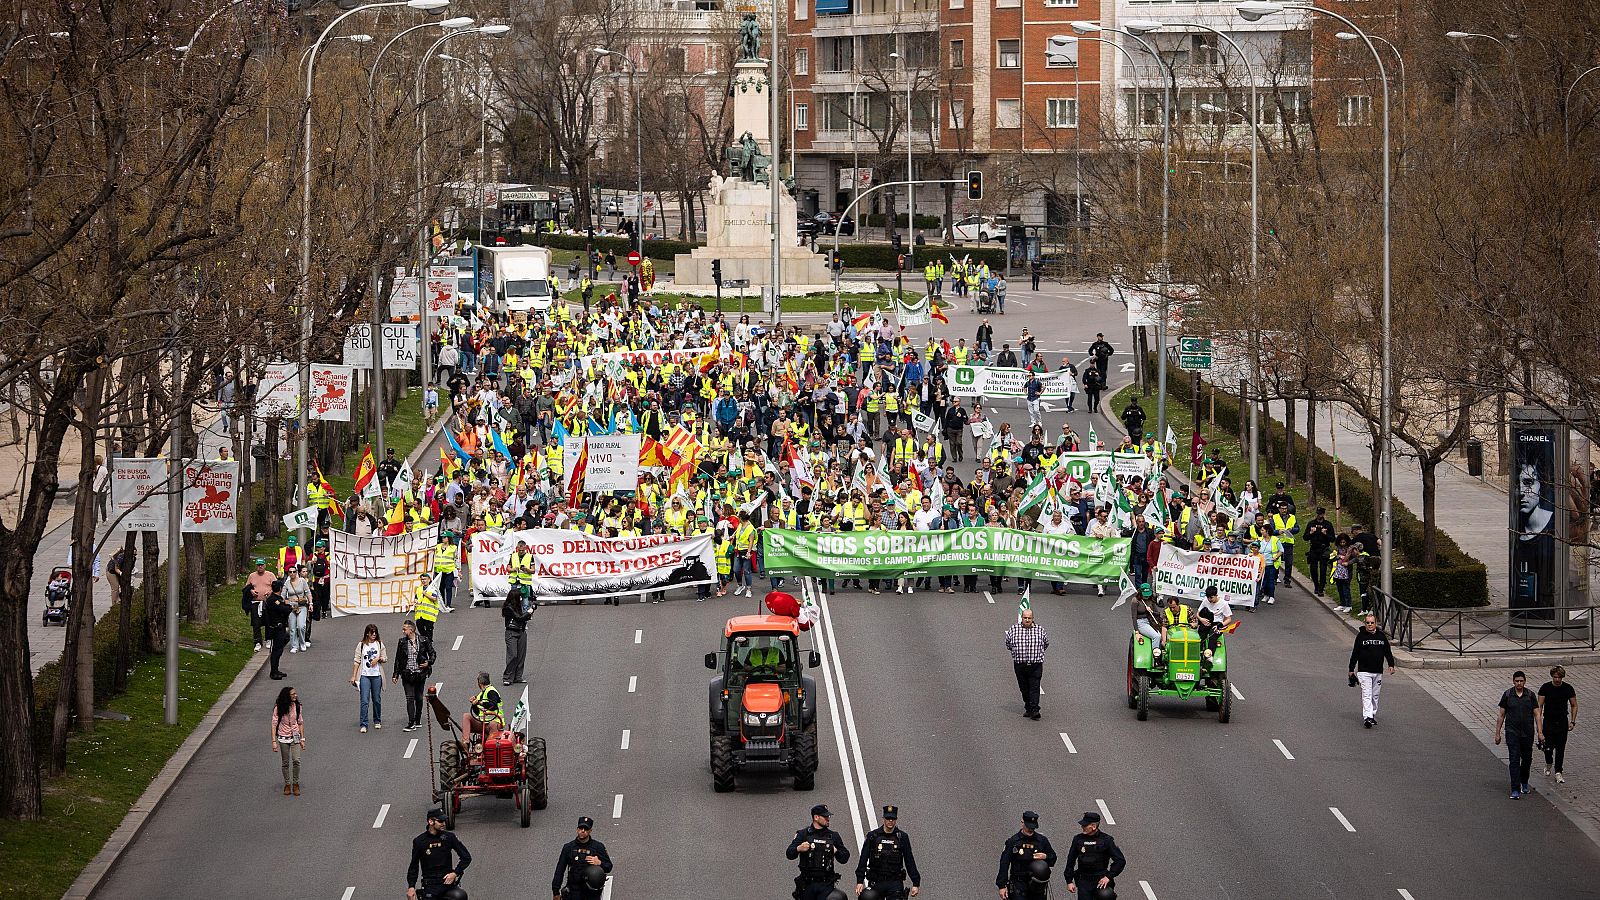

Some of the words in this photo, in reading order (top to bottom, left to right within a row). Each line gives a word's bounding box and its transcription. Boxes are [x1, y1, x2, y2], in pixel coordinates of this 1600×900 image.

[384, 327, 409, 338] CUL
[352, 339, 371, 349] RID
[388, 339, 405, 349] TU
[397, 350, 414, 361] RA
[590, 454, 612, 463] VIVO
[212, 511, 233, 519] VIDA
[816, 536, 857, 554] NOS
[864, 534, 944, 555] SOBRAN
[951, 531, 988, 550] LOS
[994, 531, 1081, 557] MOTIVOS
[538, 550, 682, 576] AGRICULTORES
[816, 557, 870, 565] DEFENDEMOS
[885, 556, 915, 565] CAMPO,
[917, 553, 970, 563] DEFENDEMOS
[984, 553, 1038, 564] ALIMENTACIÓN
[1040, 557, 1050, 565] DE
[1053, 558, 1079, 568] TODOS
[1198, 555, 1255, 569] ASOCIACIÓN
[1197, 565, 1208, 574] EN
[1211, 567, 1252, 580] DEFENSA
[1158, 570, 1173, 584] DEL
[1176, 574, 1205, 589] CAMPO
[1220, 580, 1253, 595] CUENCA
[335, 584, 356, 608] EL
